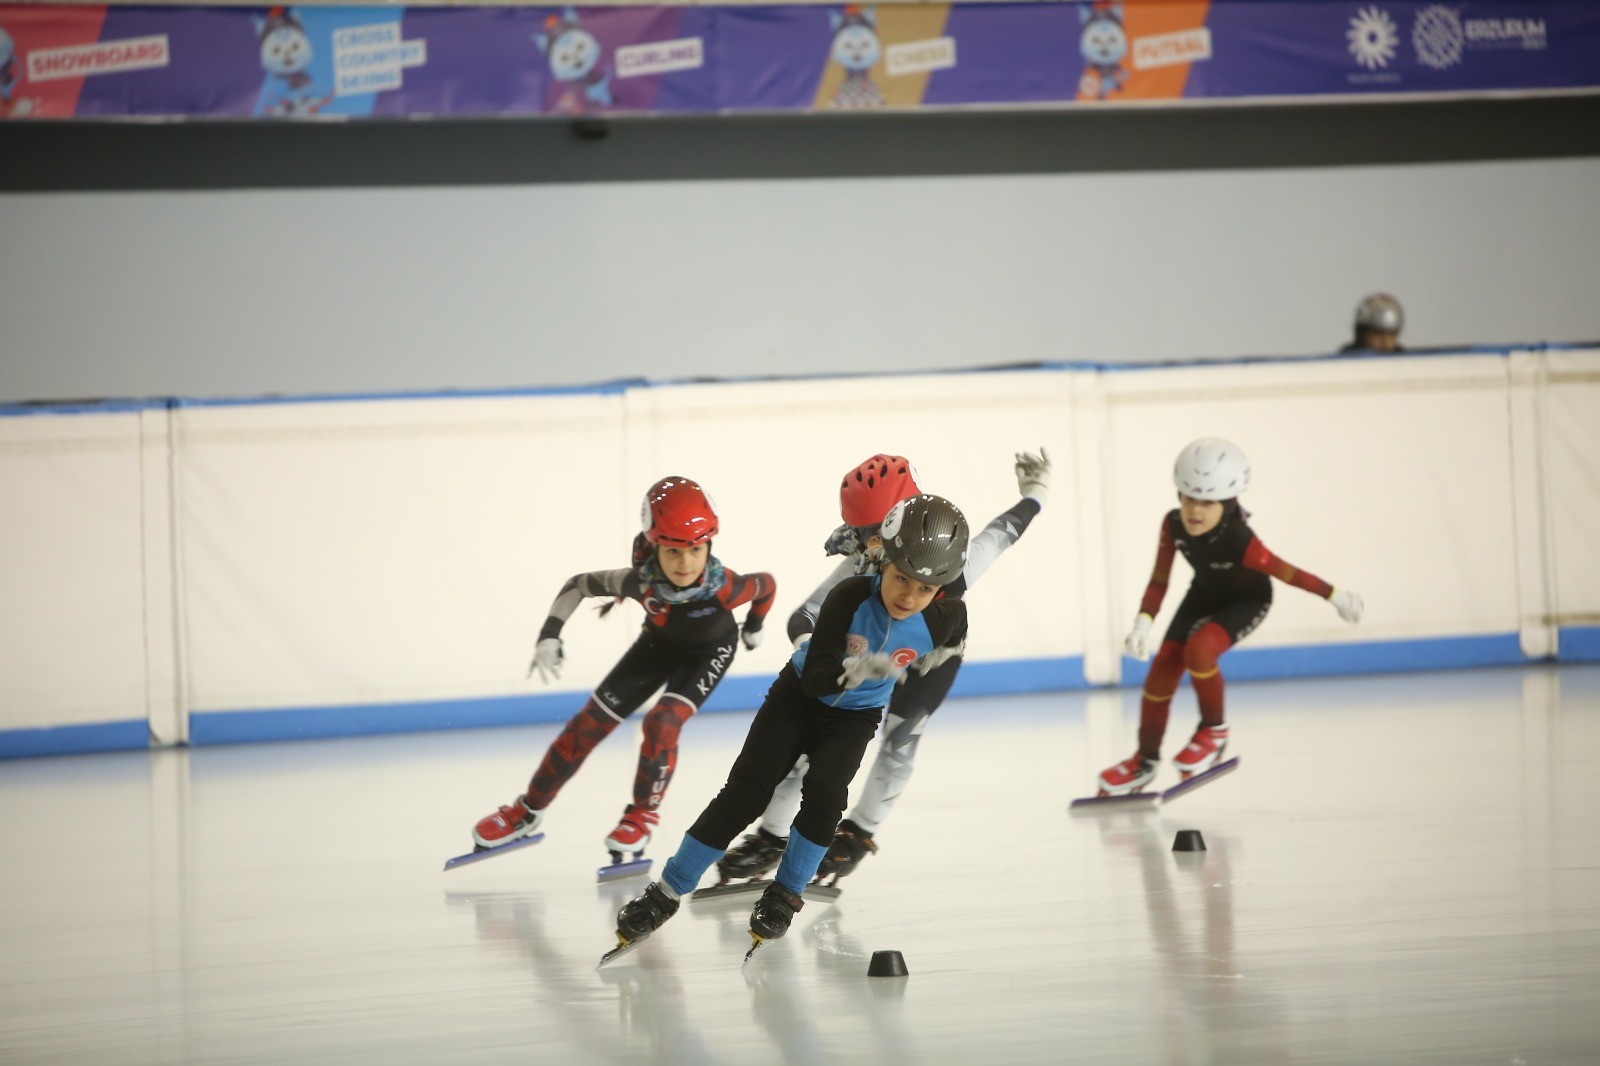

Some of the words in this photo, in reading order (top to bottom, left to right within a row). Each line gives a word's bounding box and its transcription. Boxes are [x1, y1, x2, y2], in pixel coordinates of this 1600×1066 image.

[339, 29, 395, 47] CROSS
[1140, 38, 1204, 59] FUTSAL
[34, 41, 163, 74] SNOWBOARD
[339, 45, 419, 67] COUNTRY
[623, 45, 695, 68] CURLING
[895, 46, 948, 67] CHESS
[341, 70, 396, 88] SKIING
